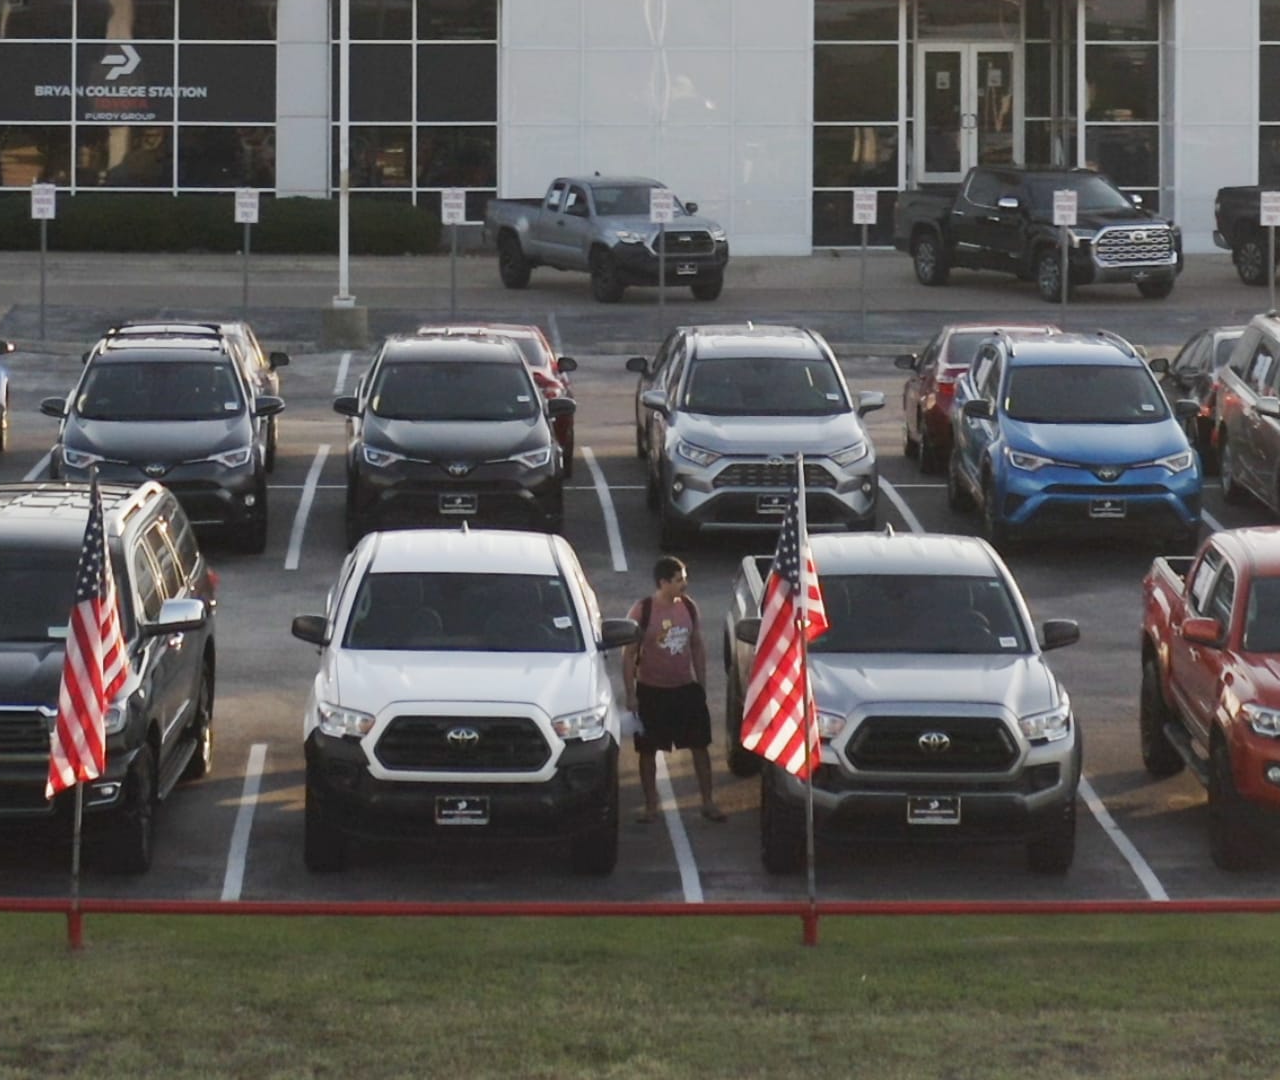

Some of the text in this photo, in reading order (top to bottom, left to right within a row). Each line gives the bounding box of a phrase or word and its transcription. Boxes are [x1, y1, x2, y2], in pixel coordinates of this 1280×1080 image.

[34, 85, 207, 98] BRYAN COLLEGE STATION
[85, 112, 156, 121] PURDY GROUP
